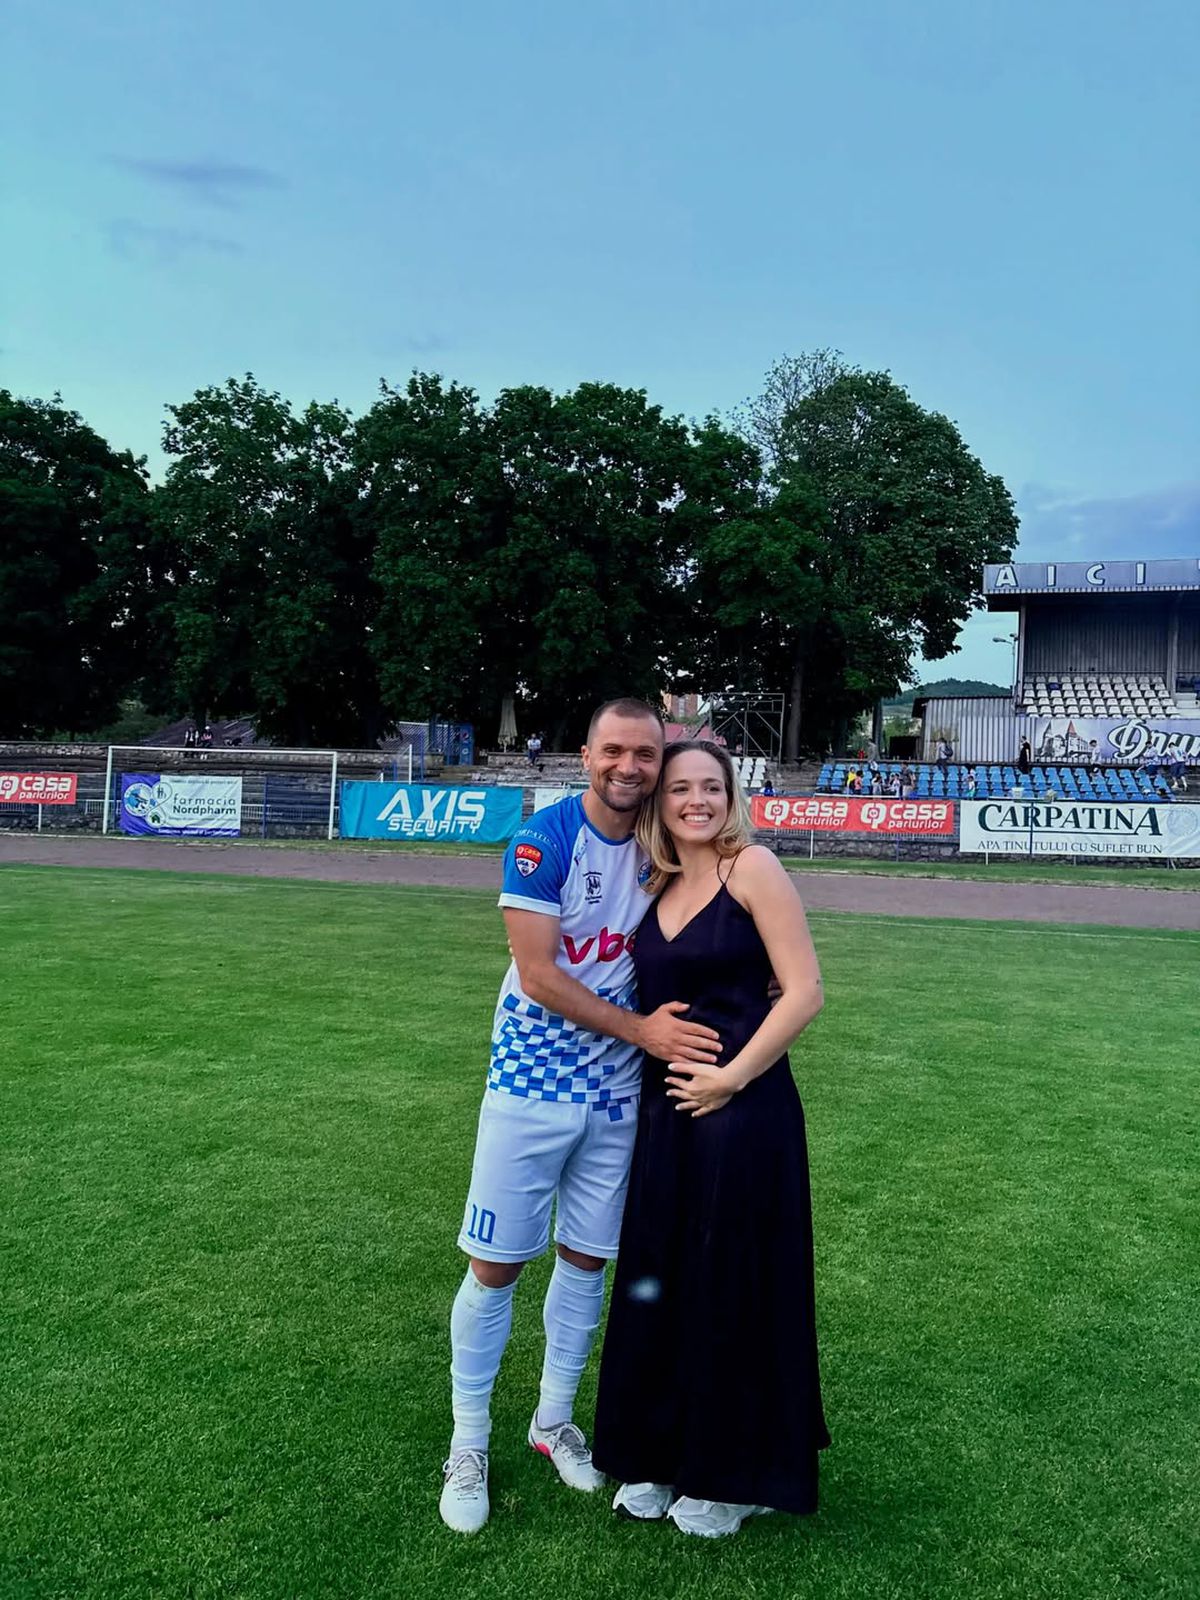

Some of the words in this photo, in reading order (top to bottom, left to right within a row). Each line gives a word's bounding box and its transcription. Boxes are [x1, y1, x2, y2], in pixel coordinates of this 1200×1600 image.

[22, 776, 72, 792] casa
[19, 791, 69, 800] pariurilor
[173, 794, 236, 806] farmacia
[172, 805, 237, 816] Nordpharm
[376, 788, 487, 822] AXIS
[792, 801, 849, 817] casa
[889, 803, 947, 820] casa
[387, 818, 482, 836] SECURITY
[790, 816, 846, 826] pariurilor
[887, 819, 945, 829] pariurilor
[978, 804, 1163, 836] CARPATINA
[977, 840, 1000, 850] APA
[1071, 842, 1088, 852] CU
[1090, 843, 1134, 853] SUFLET
[1136, 844, 1163, 854] BUN
[467, 1203, 496, 1245] 10
